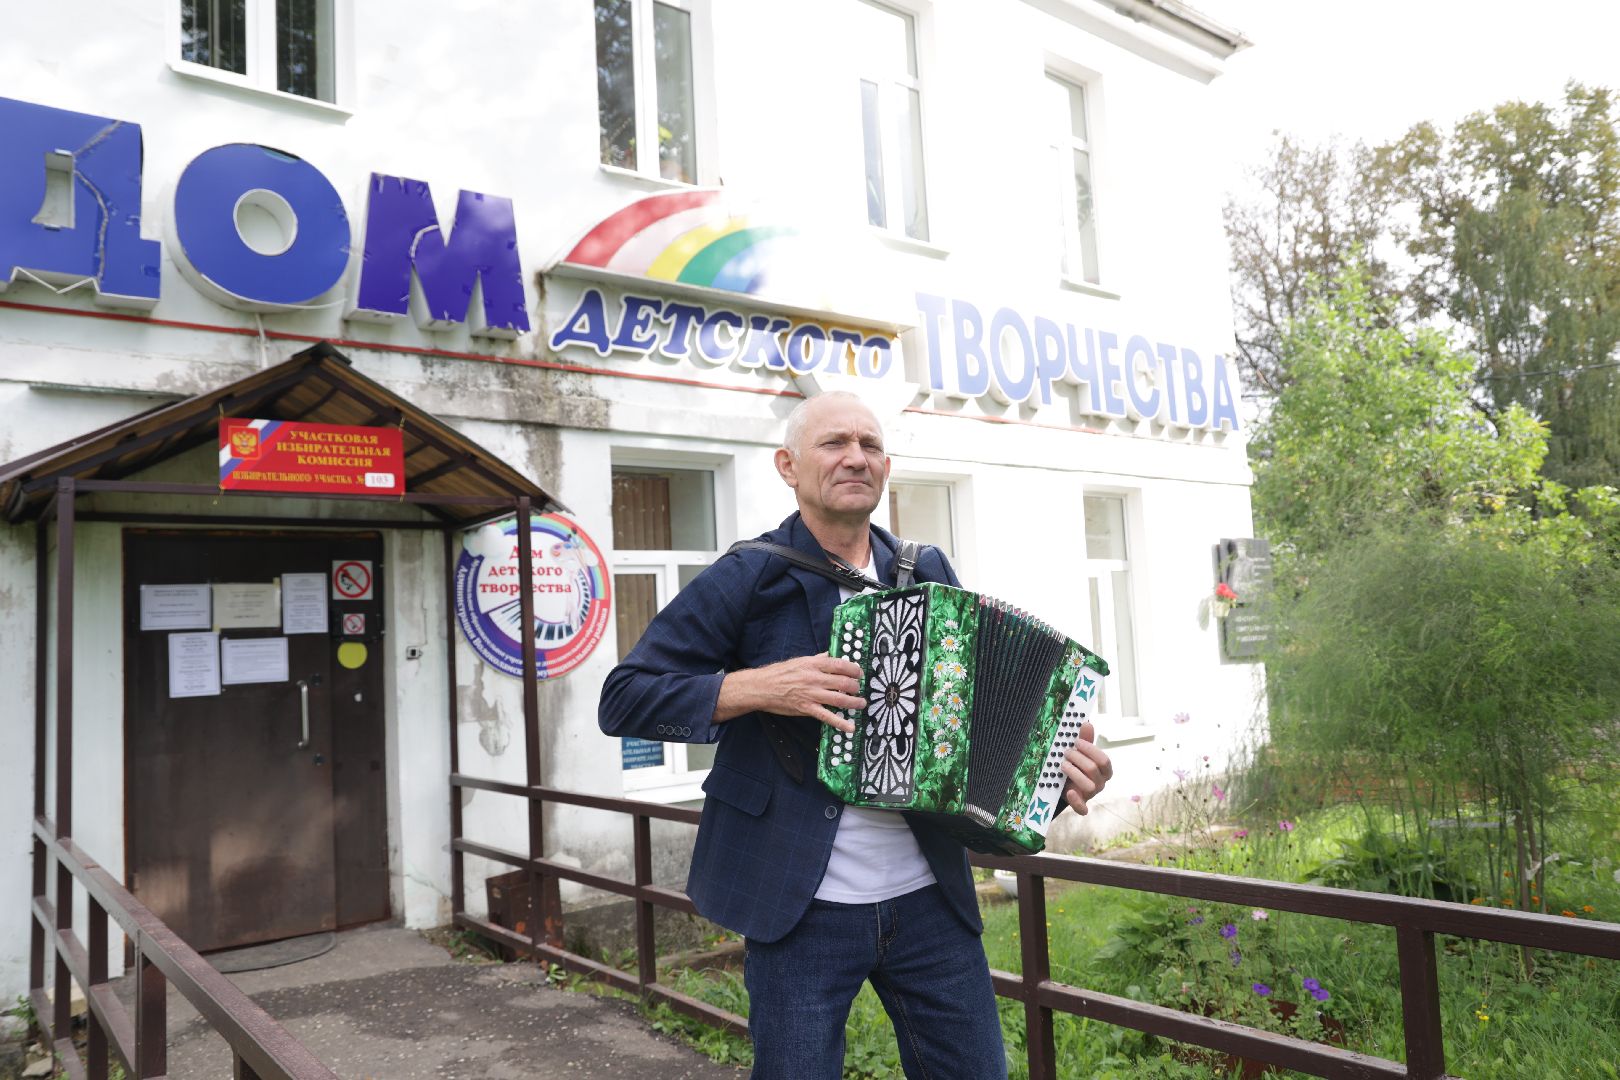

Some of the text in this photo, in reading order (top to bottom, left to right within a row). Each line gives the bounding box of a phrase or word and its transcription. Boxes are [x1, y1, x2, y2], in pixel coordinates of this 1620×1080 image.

[0, 97, 1239, 432] ДОМ ДЕТСКОГО ТВОРЧЕСТВА
[290, 430, 378, 444] УЧАСТКОВАЯ
[276, 442, 391, 456] ИЗБИРАТЕЛЬНАЯ
[297, 455, 373, 468] КОМИССИЯ
[232, 471, 312, 482] ИЗБИРАТЕЛЬНОГО
[314, 474, 353, 484] УЧАСТКА
[509, 545, 543, 560] Дм
[488, 566, 563, 577] детого
[480, 583, 572, 596] творества
[472, 637, 524, 676] Волоколамск
